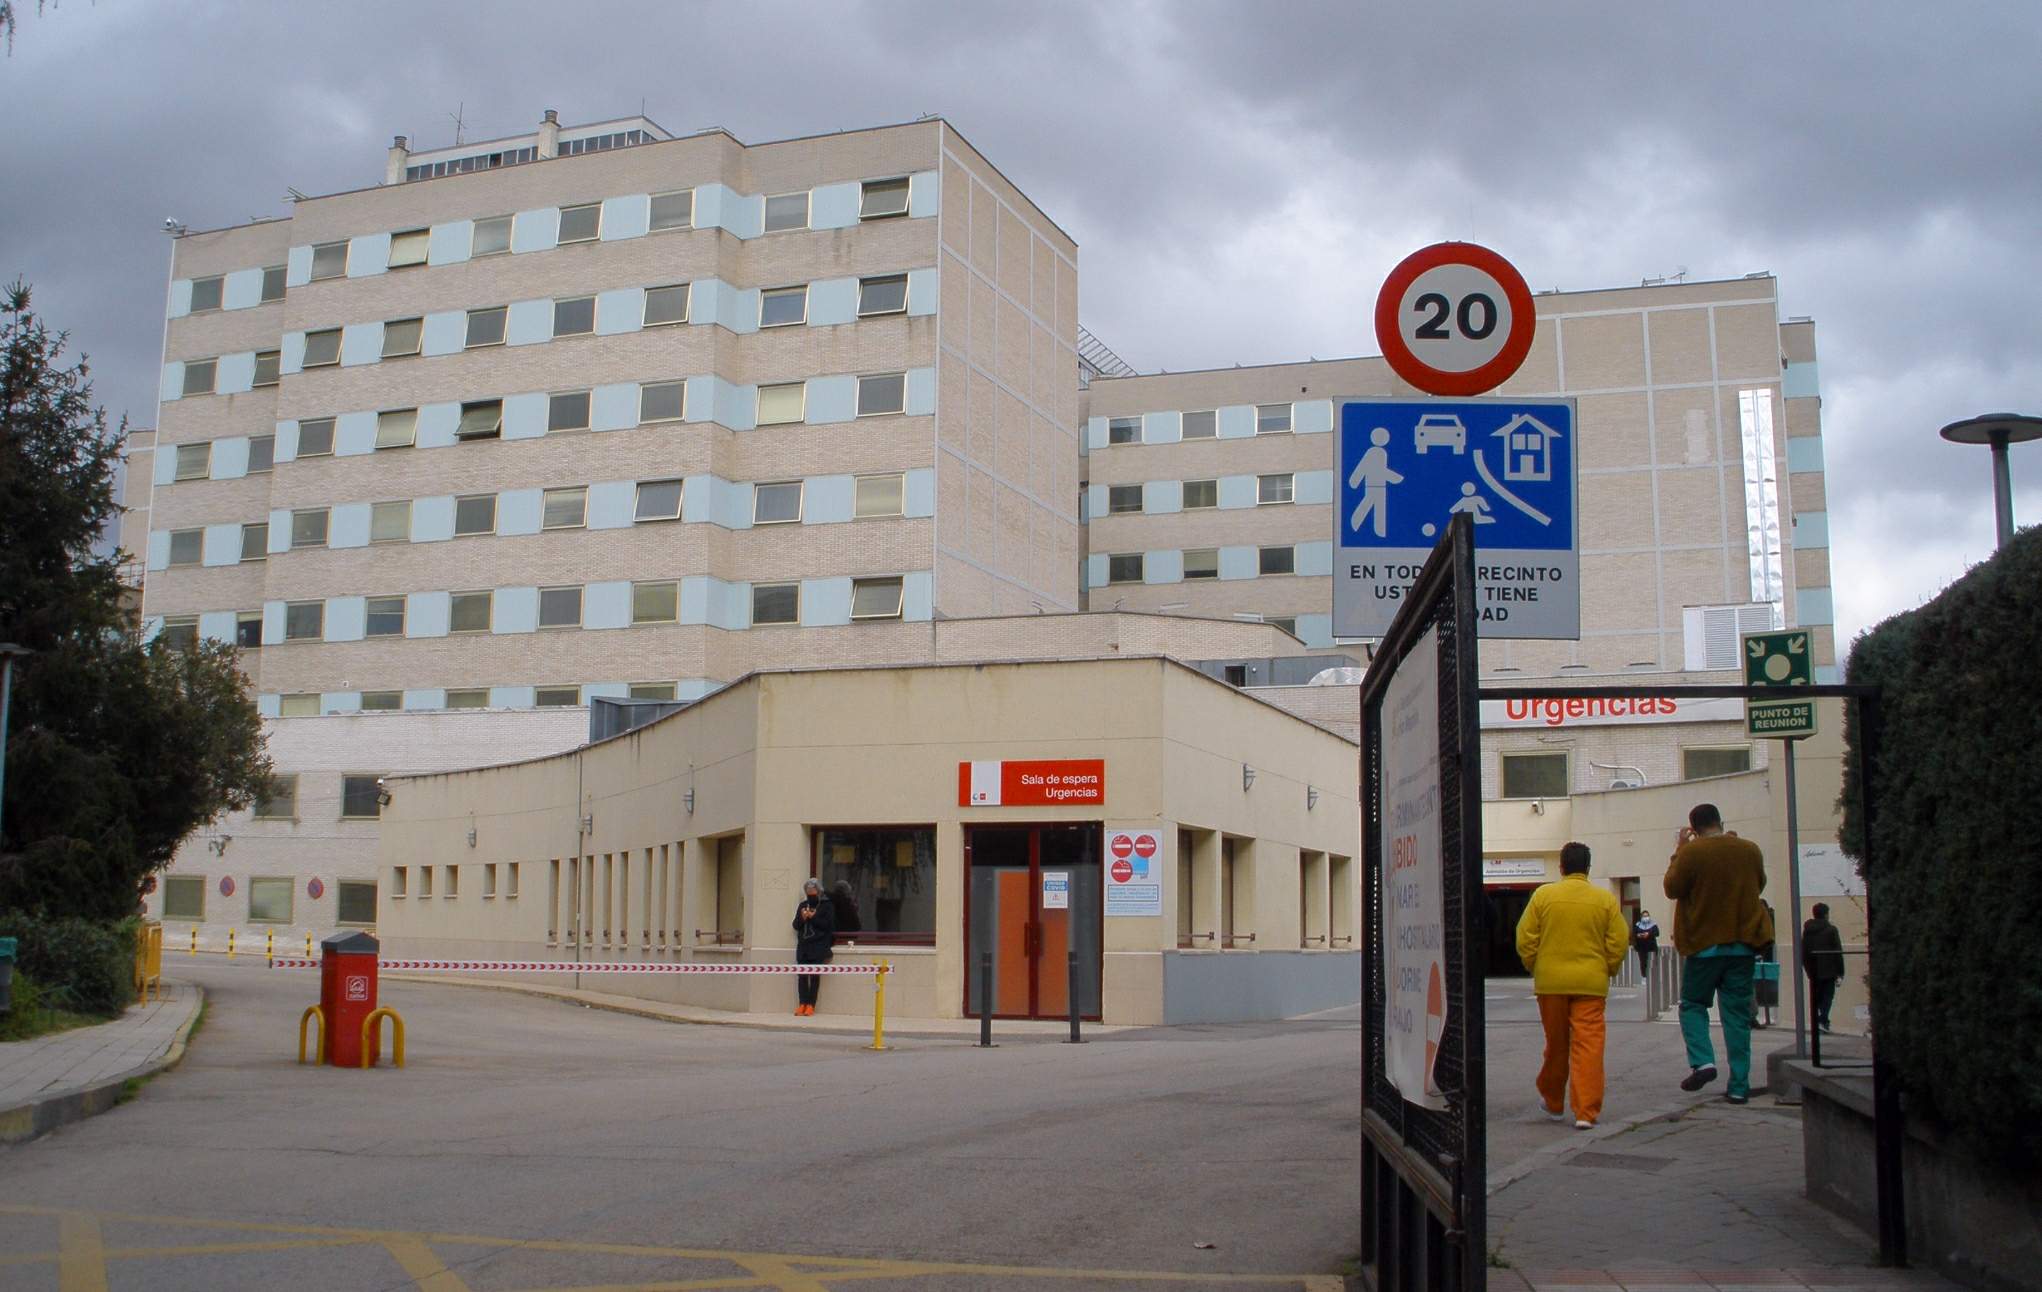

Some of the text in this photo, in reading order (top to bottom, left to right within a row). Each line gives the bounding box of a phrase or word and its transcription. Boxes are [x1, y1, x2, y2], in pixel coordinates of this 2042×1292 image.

[1413, 293, 1497, 340] 20
[1350, 565, 1562, 581] EN TOD RECINTO
[1375, 585, 1538, 602] UST TIENE
[1506, 696, 1677, 726] Urgencias
[1752, 706, 1808, 719] PUNTO DE
[1021, 774, 1098, 786] Sala de espera
[1045, 787, 1098, 800] Urgencias
